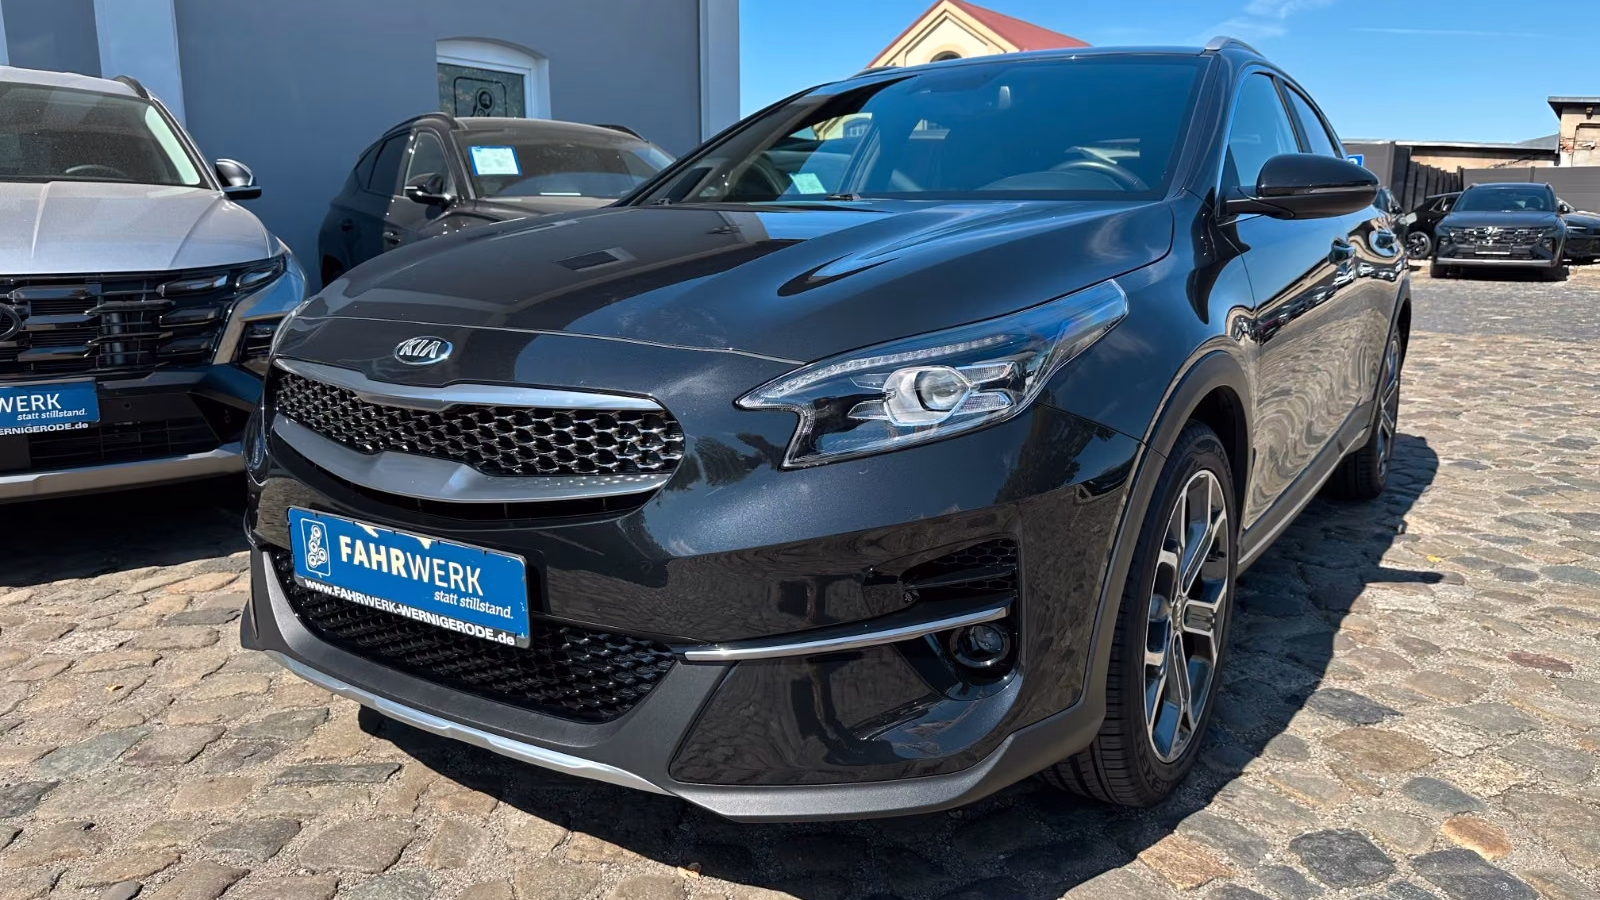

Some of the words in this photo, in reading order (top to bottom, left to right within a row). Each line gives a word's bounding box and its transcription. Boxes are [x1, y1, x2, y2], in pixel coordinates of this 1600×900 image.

[399, 339, 441, 358] KIA
[17, 412, 40, 421] statt
[41, 408, 88, 419] stillstand.
[338, 535, 484, 596] FAHRWERK
[304, 579, 515, 646] www.FAHRWERK-WERNIGERODE.de
[433, 590, 458, 606] statt
[459, 597, 514, 619] stillstand.
